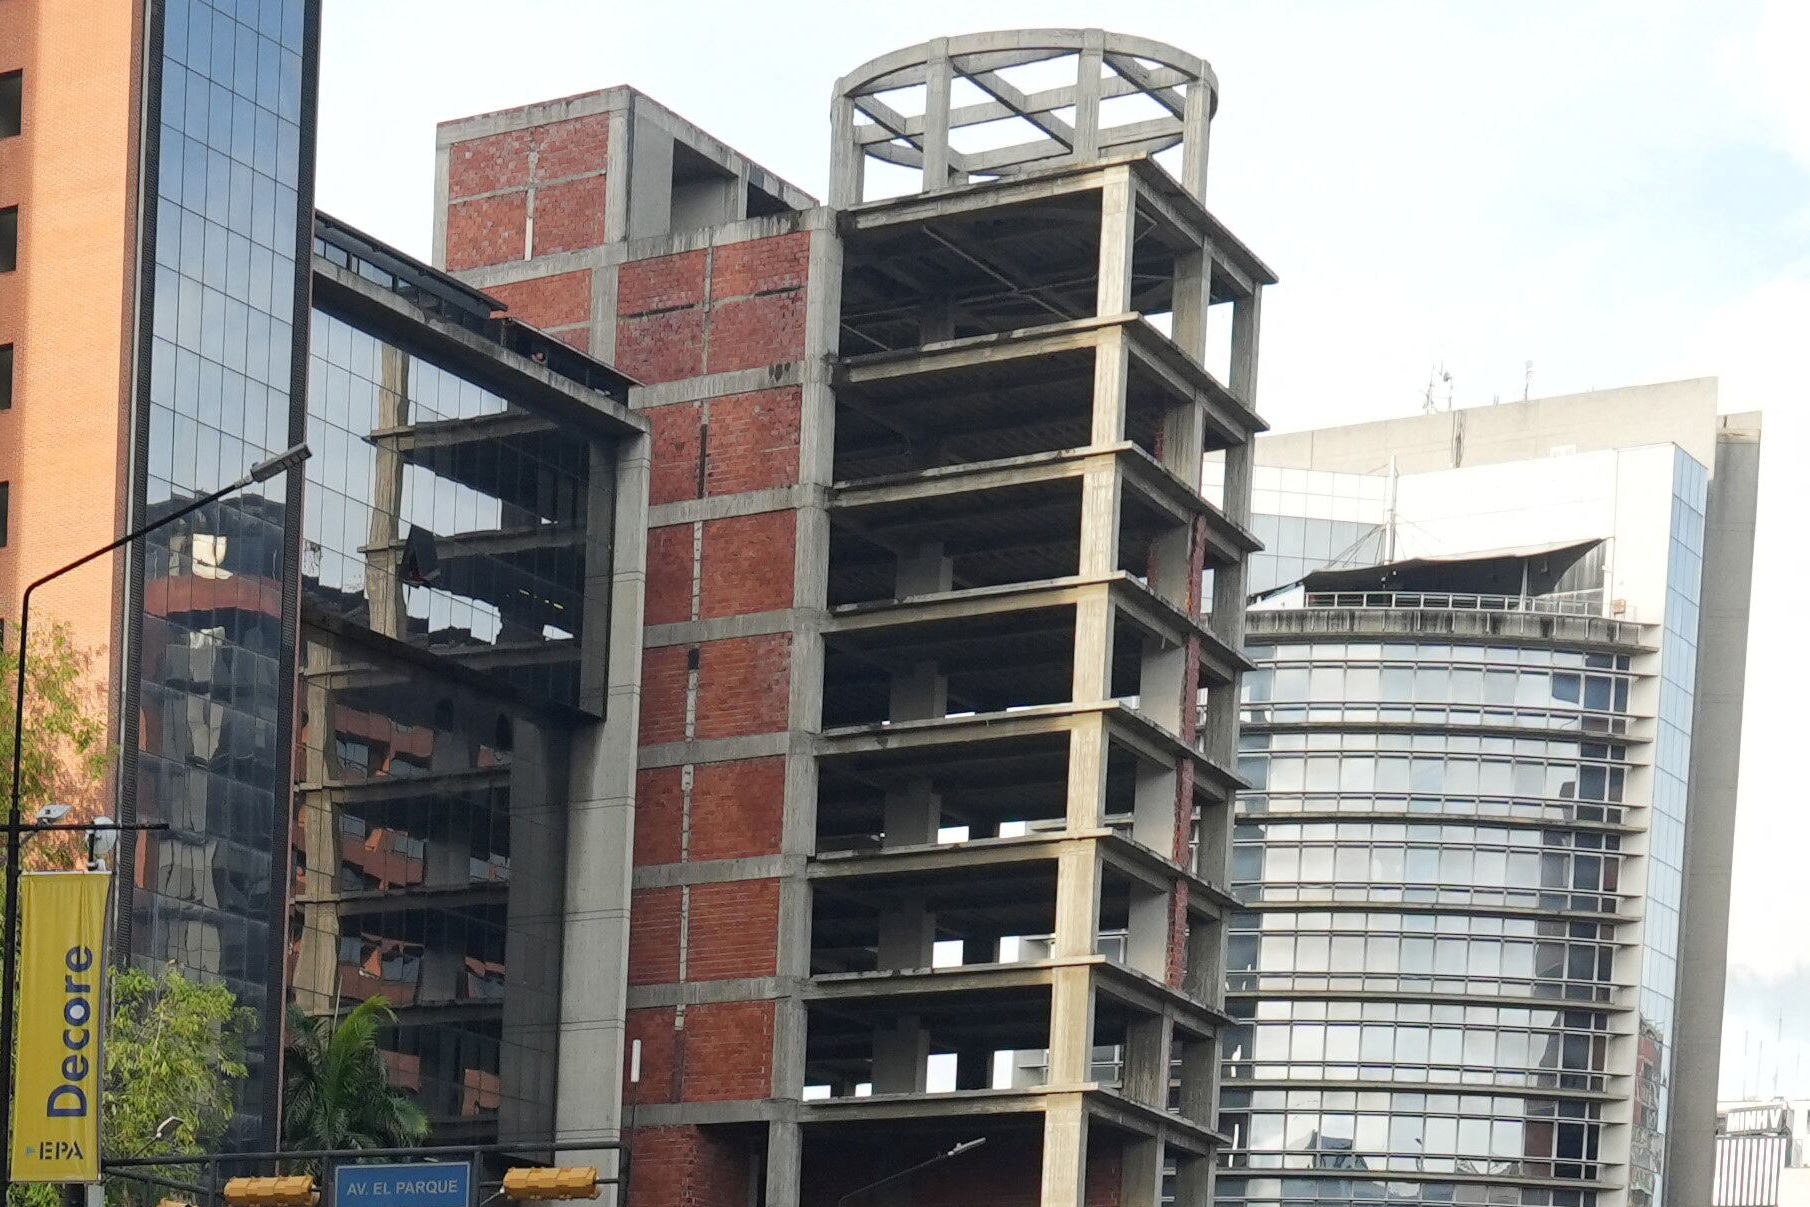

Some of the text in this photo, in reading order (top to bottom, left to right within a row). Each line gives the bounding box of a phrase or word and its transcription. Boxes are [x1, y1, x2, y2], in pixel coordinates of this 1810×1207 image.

[47, 945, 93, 1117] Decore
[39, 1140, 84, 1160] EPA
[347, 1178, 458, 1196] AV. EL PARQUE
